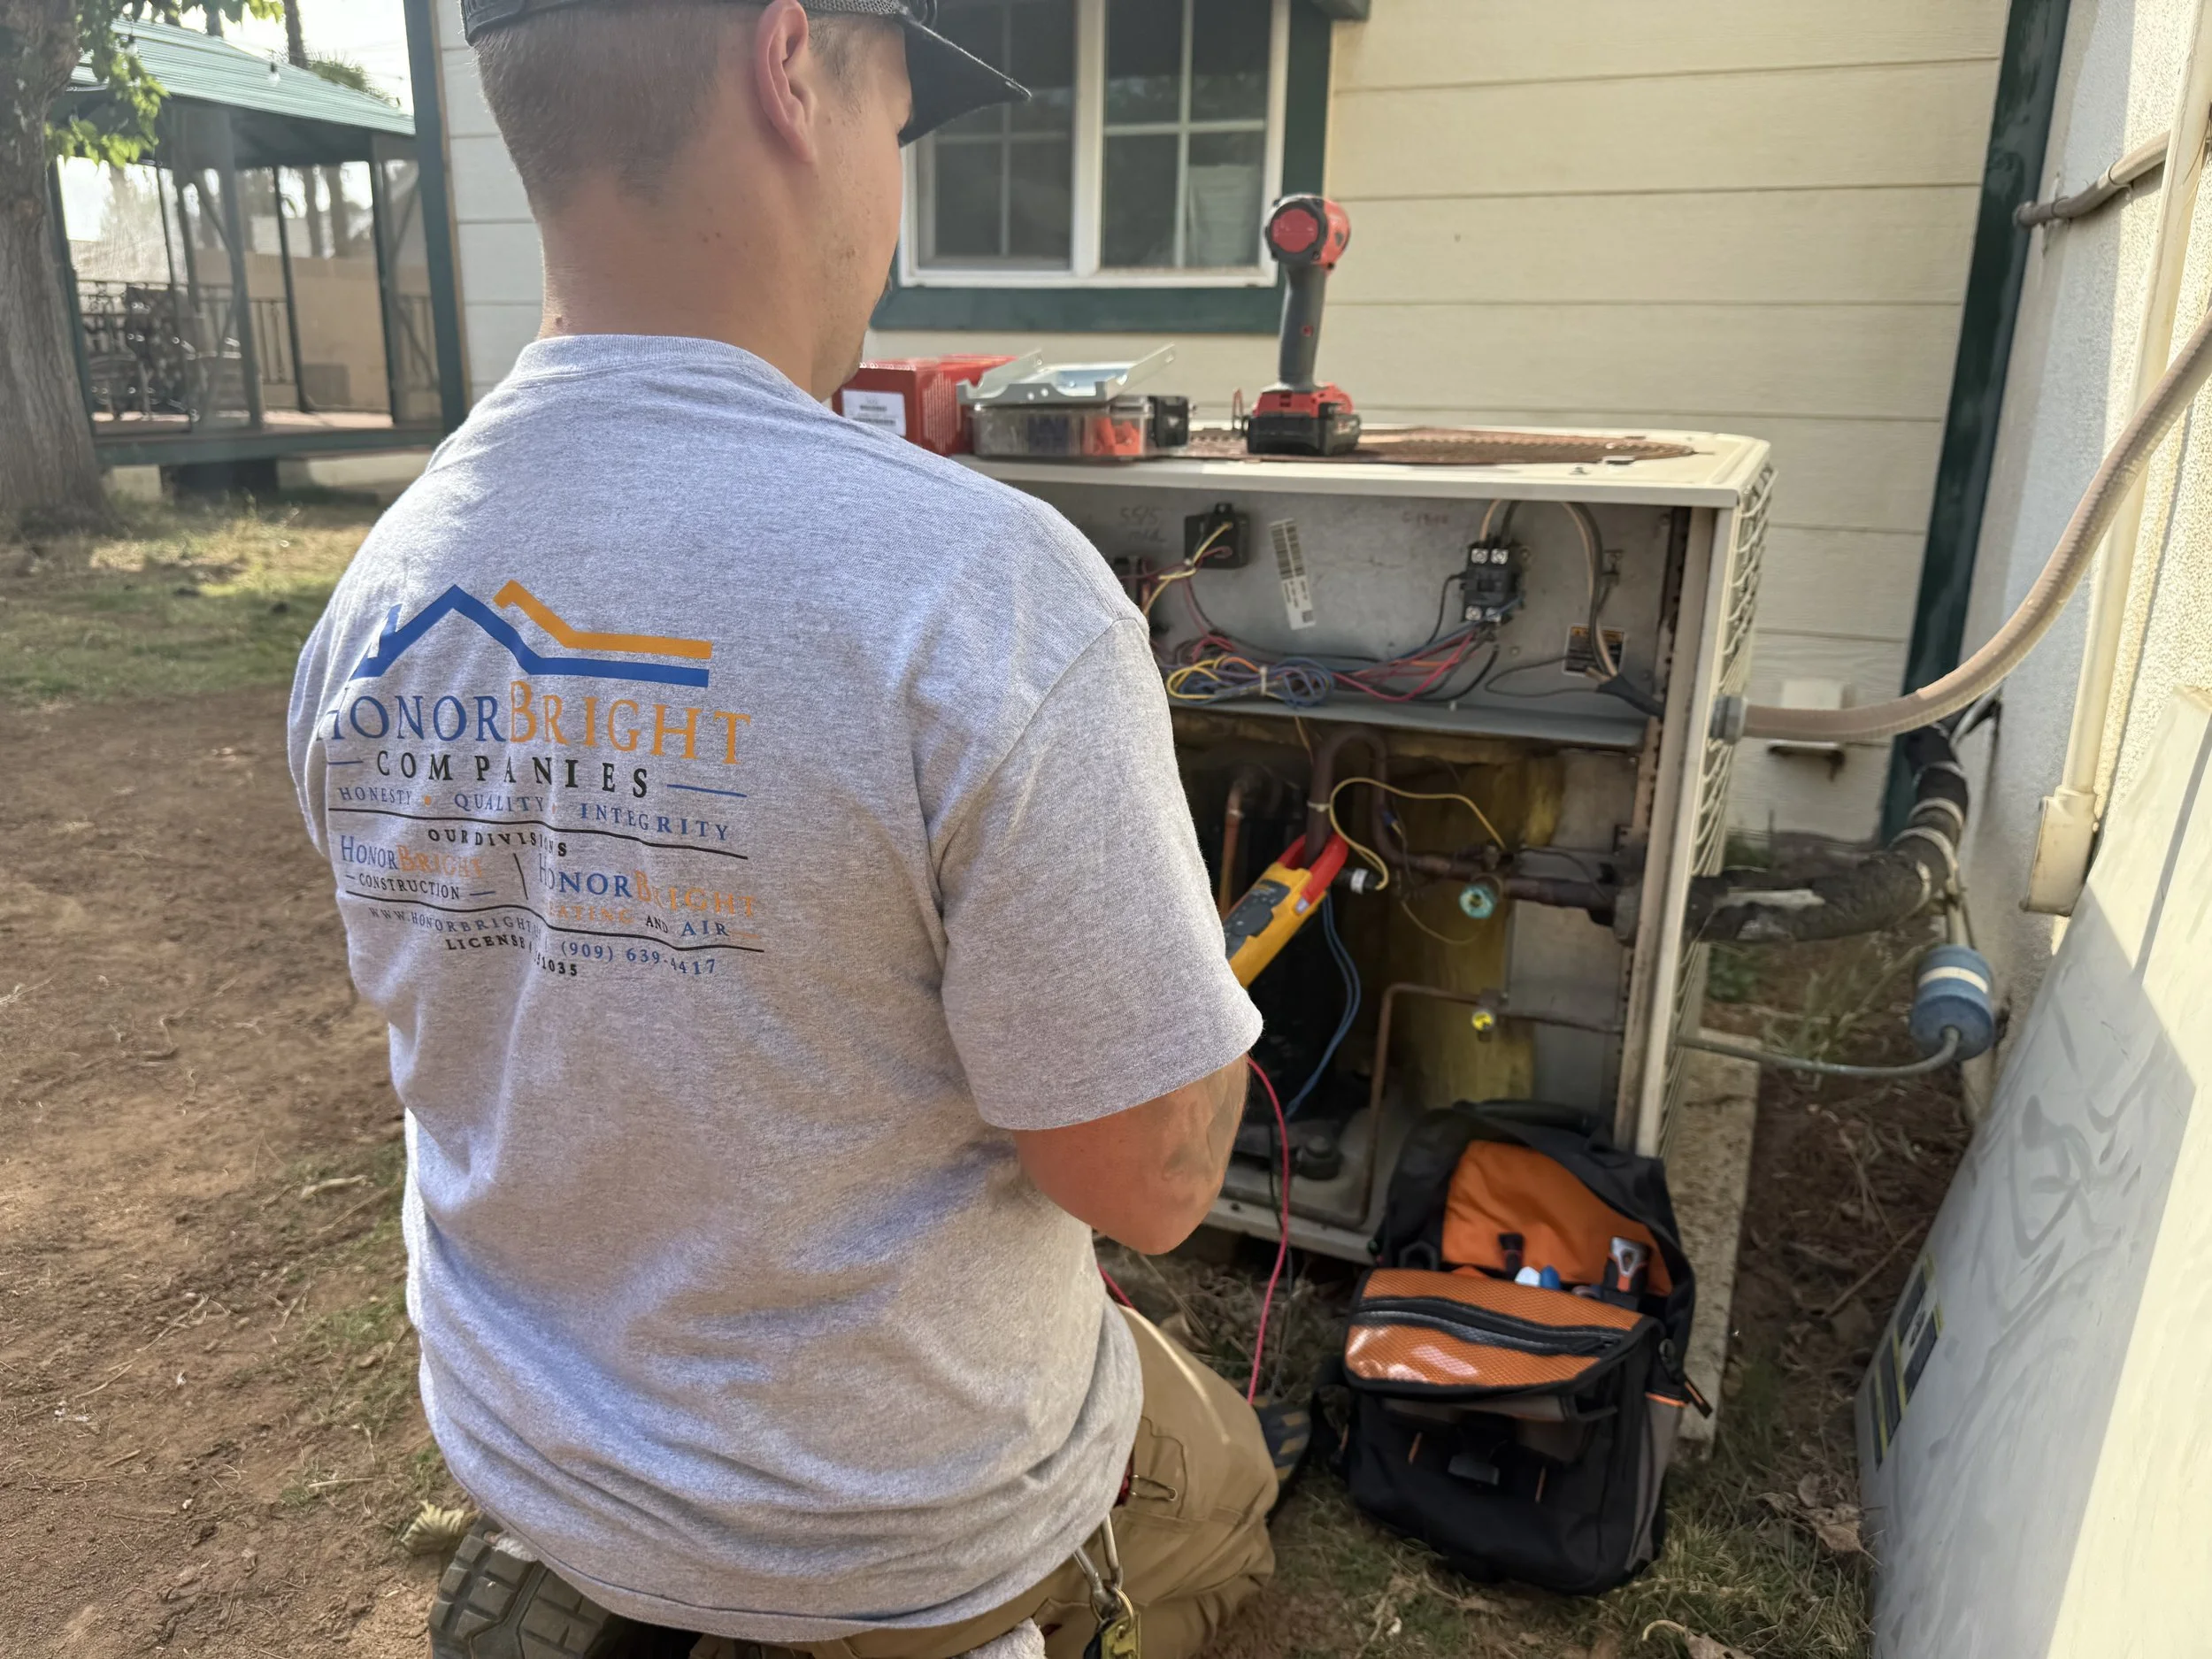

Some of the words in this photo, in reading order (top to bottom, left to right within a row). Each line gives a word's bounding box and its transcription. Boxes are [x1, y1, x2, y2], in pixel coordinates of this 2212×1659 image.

[377, 750, 648, 798] COMPANIES
[340, 787, 413, 805] HONESTY
[455, 794, 544, 812] QUALITY
[581, 803, 728, 840] INTEGRITY
[358, 872, 460, 900] CONSTRUCTION
[646, 915, 668, 933] AND
[680, 920, 730, 936] AIR
[446, 933, 526, 951] LICENSE
[561, 941, 613, 962] (909)
[626, 949, 715, 974] 639-4417
